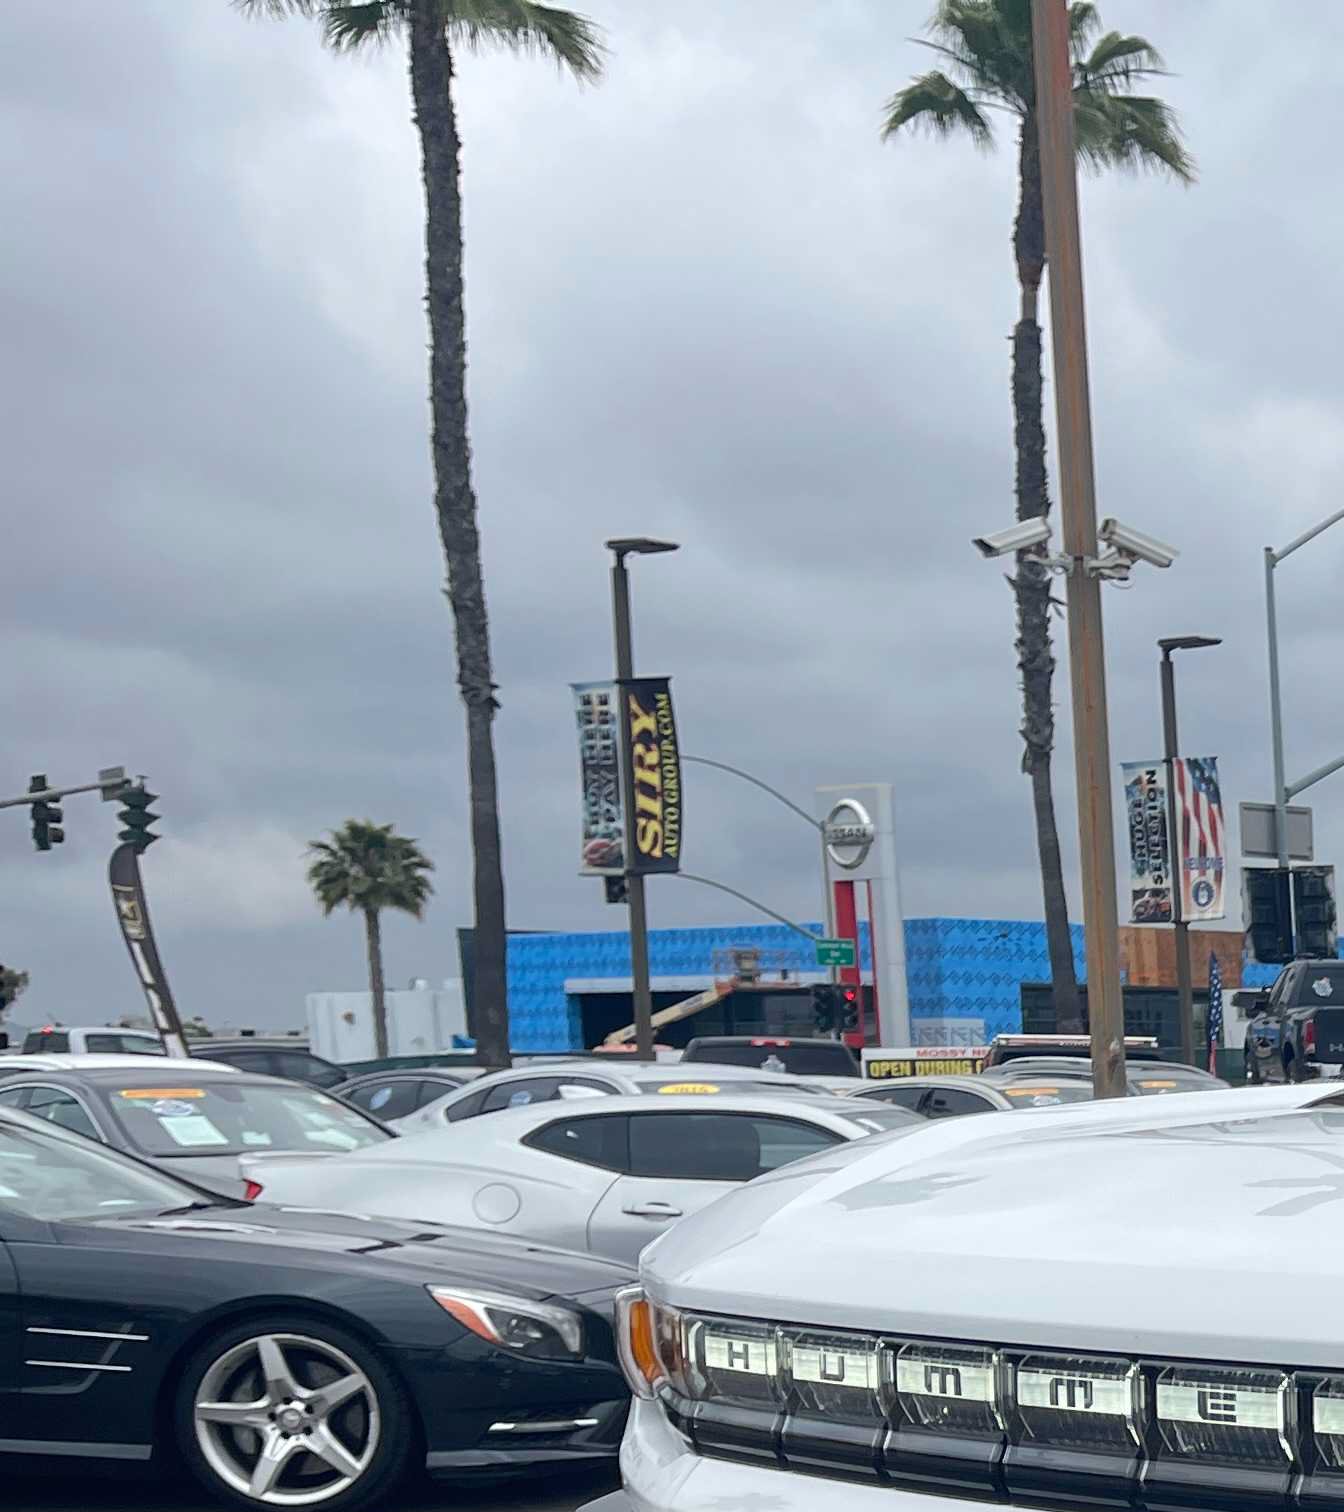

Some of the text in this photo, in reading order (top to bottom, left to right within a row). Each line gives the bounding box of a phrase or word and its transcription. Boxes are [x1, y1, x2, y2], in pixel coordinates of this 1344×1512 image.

[597, 693, 616, 766] HERE
[628, 693, 664, 858] SIRY
[655, 692, 680, 858] AUTO GROUP.COM
[1133, 798, 1148, 861] HUGE
[1144, 768, 1165, 886] SELECTION
[869, 1060, 911, 1078] OPEN
[914, 1059, 973, 1076] DURING
